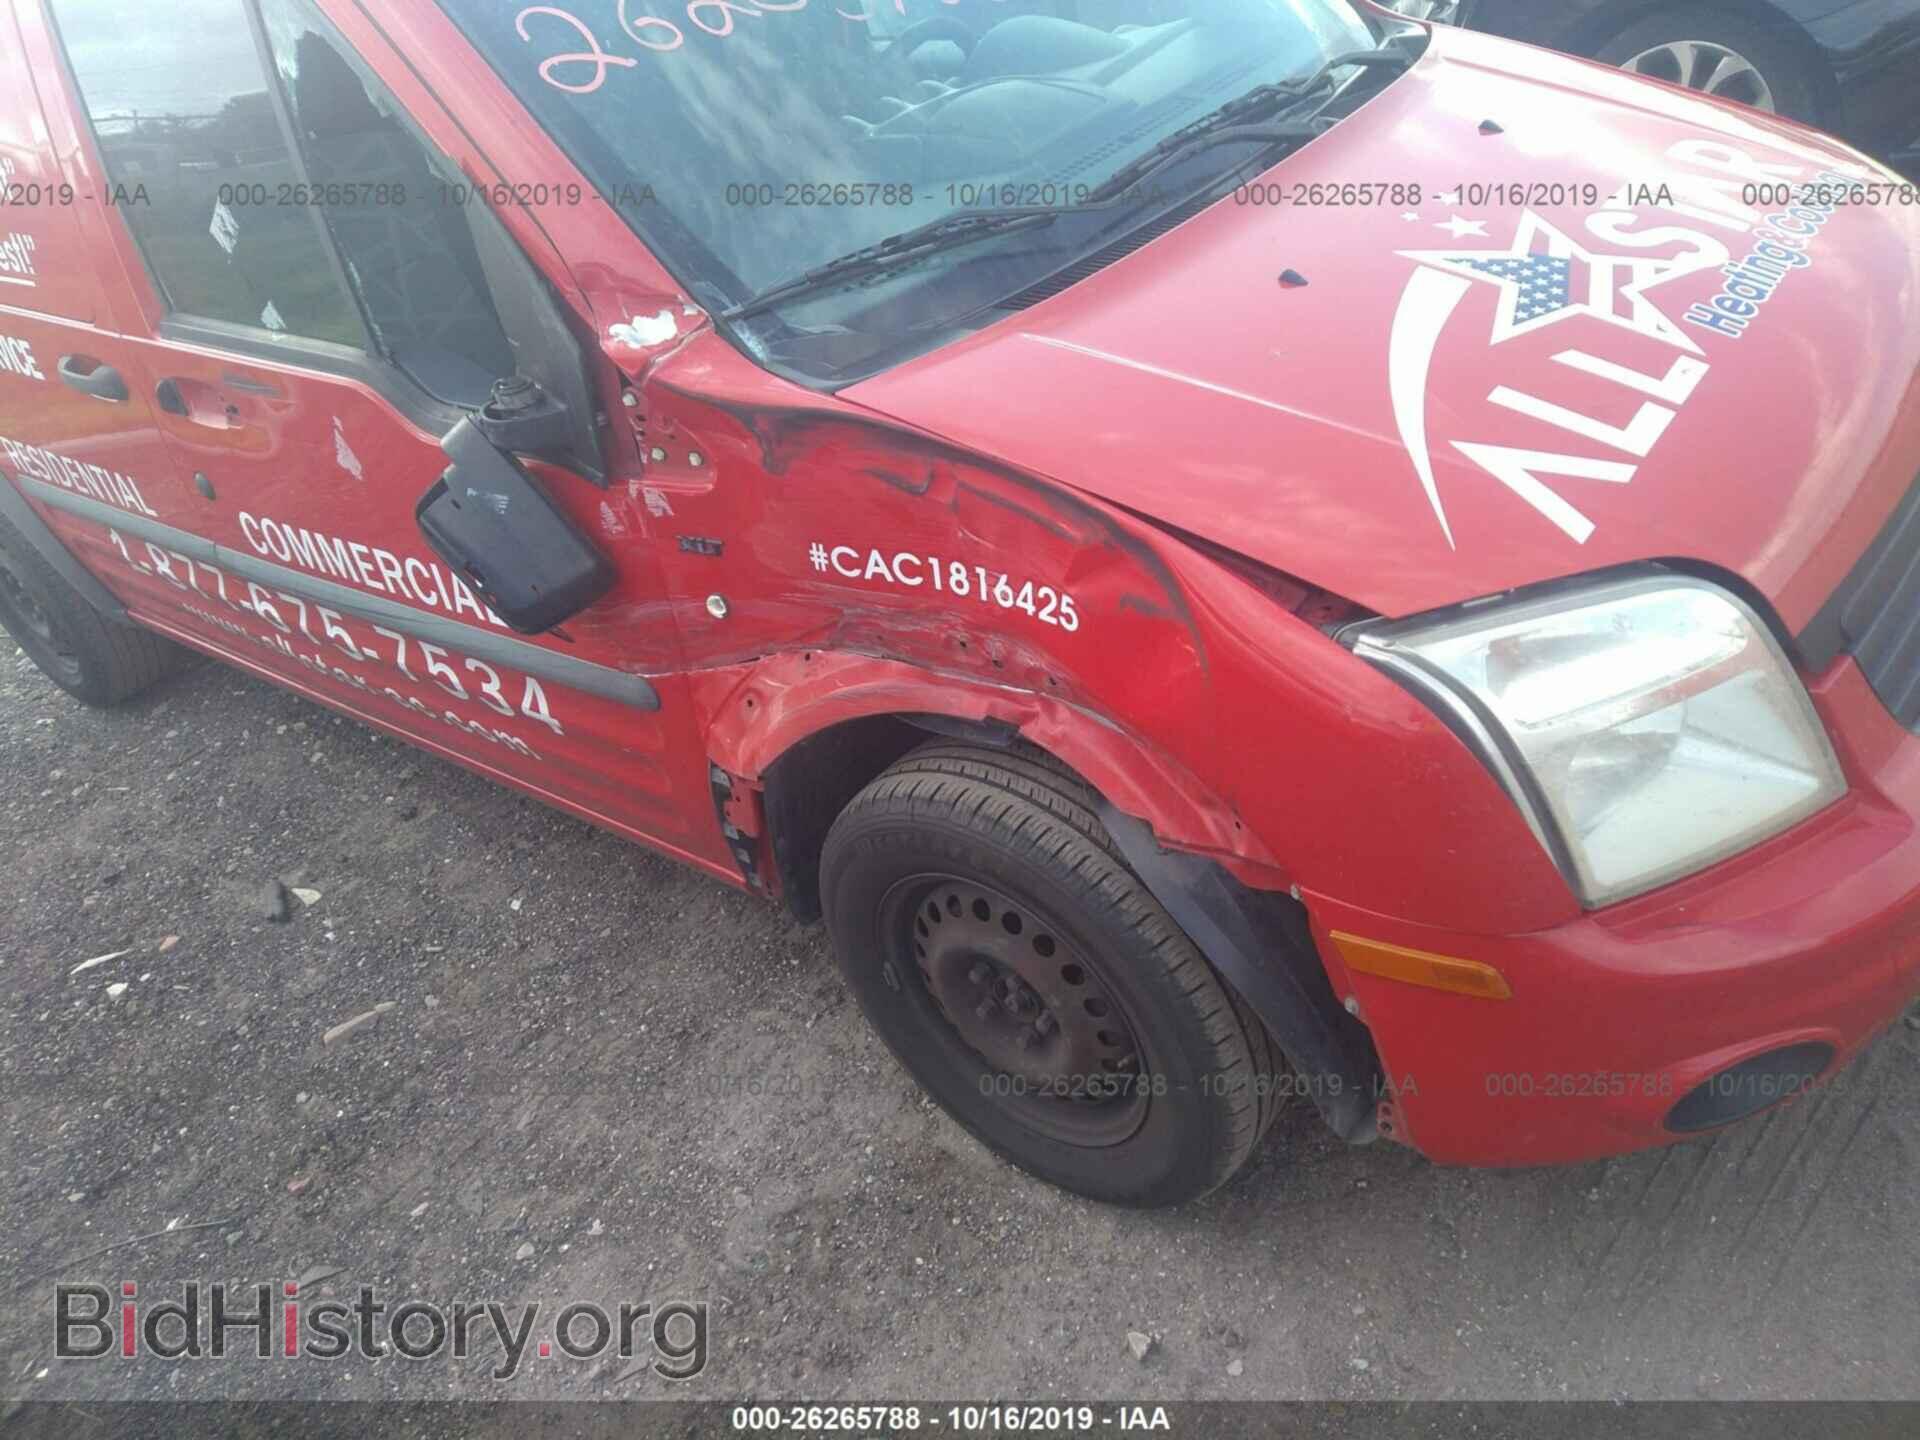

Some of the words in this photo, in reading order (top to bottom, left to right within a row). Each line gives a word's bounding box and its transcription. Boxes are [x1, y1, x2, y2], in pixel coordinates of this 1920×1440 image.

[1684, 238, 1811, 338] Heating
[109, 527, 564, 736] 1-877-675-7534
[809, 542, 1080, 633] #CAC1816425
